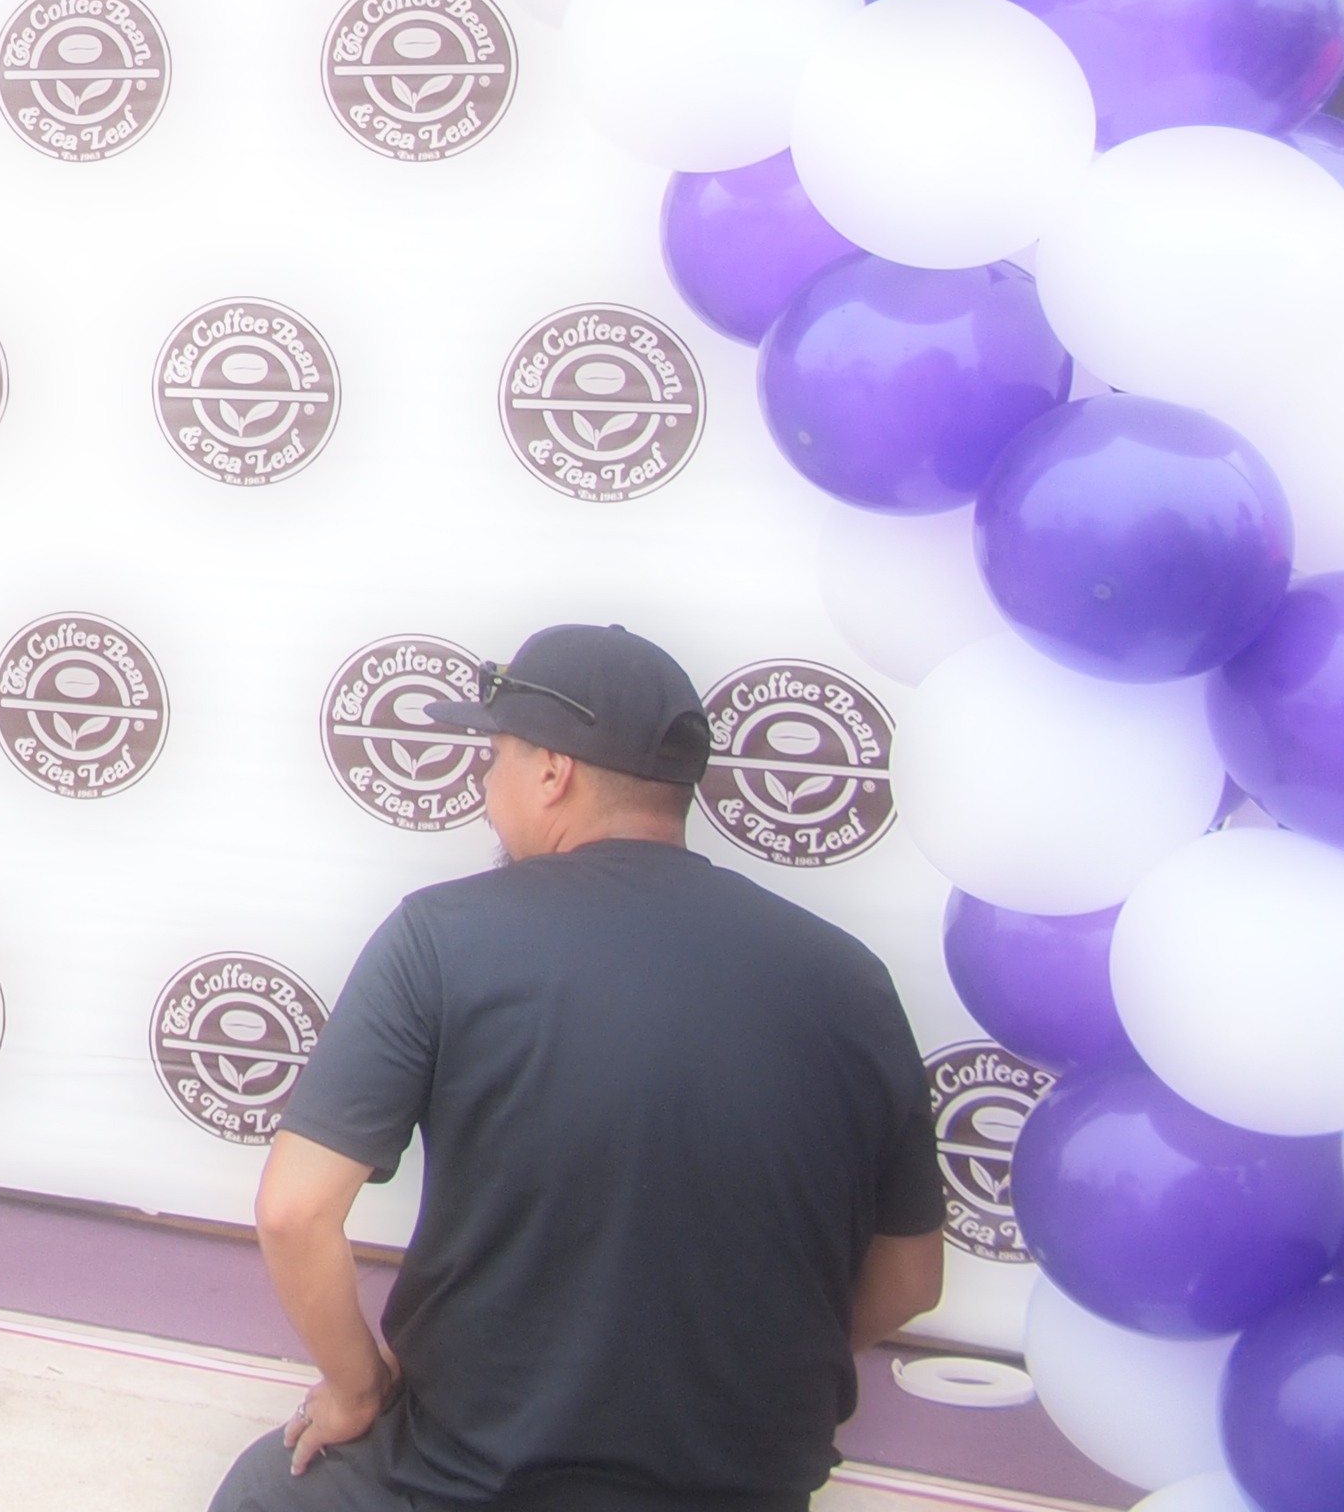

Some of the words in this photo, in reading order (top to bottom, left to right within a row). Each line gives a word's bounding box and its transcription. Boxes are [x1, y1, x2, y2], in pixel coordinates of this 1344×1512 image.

[3, 27, 36, 67] The
[333, 20, 369, 62] The
[18, 106, 40, 130] &
[39, 117, 78, 151] Tea
[80, 104, 138, 150] Leaf
[349, 103, 374, 129] &
[372, 115, 415, 150] Tea
[418, 101, 482, 149] Leaf
[163, 343, 198, 384] The
[192, 308, 269, 347] Coffee
[272, 318, 319, 389] Bean
[511, 352, 549, 394] The
[542, 314, 627, 356] Coffee
[630, 325, 682, 400] Bean
[179, 426, 202, 451] &
[201, 438, 242, 474] Tea
[245, 428, 306, 474] Leaf
[528, 439, 553, 465] &
[552, 452, 597, 490] Tea
[600, 441, 667, 490] Leaf
[0, 655, 33, 695] The
[27, 623, 101, 660] Coffee
[103, 634, 149, 706] Bean
[332, 680, 369, 722] The
[362, 646, 443, 684] Coffee
[732, 671, 821, 712] Coffee
[824, 684, 880, 764] Bean
[14, 737, 37, 761] &
[35, 750, 75, 787] Tea
[77, 744, 136, 788] Leaf
[349, 766, 373, 792] &
[372, 780, 415, 819] Tea
[418, 774, 482, 820] Leaf
[718, 798, 745, 826] &
[743, 813, 792, 854] Tea
[795, 806, 866, 855] Leaf
[161, 995, 196, 1035] The
[190, 964, 267, 1000] Coffee
[936, 1054, 1029, 1094] Coffee
[177, 1079, 201, 1104] &
[199, 1092, 241, 1132] Tea
[947, 1200, 996, 1246] Tea
